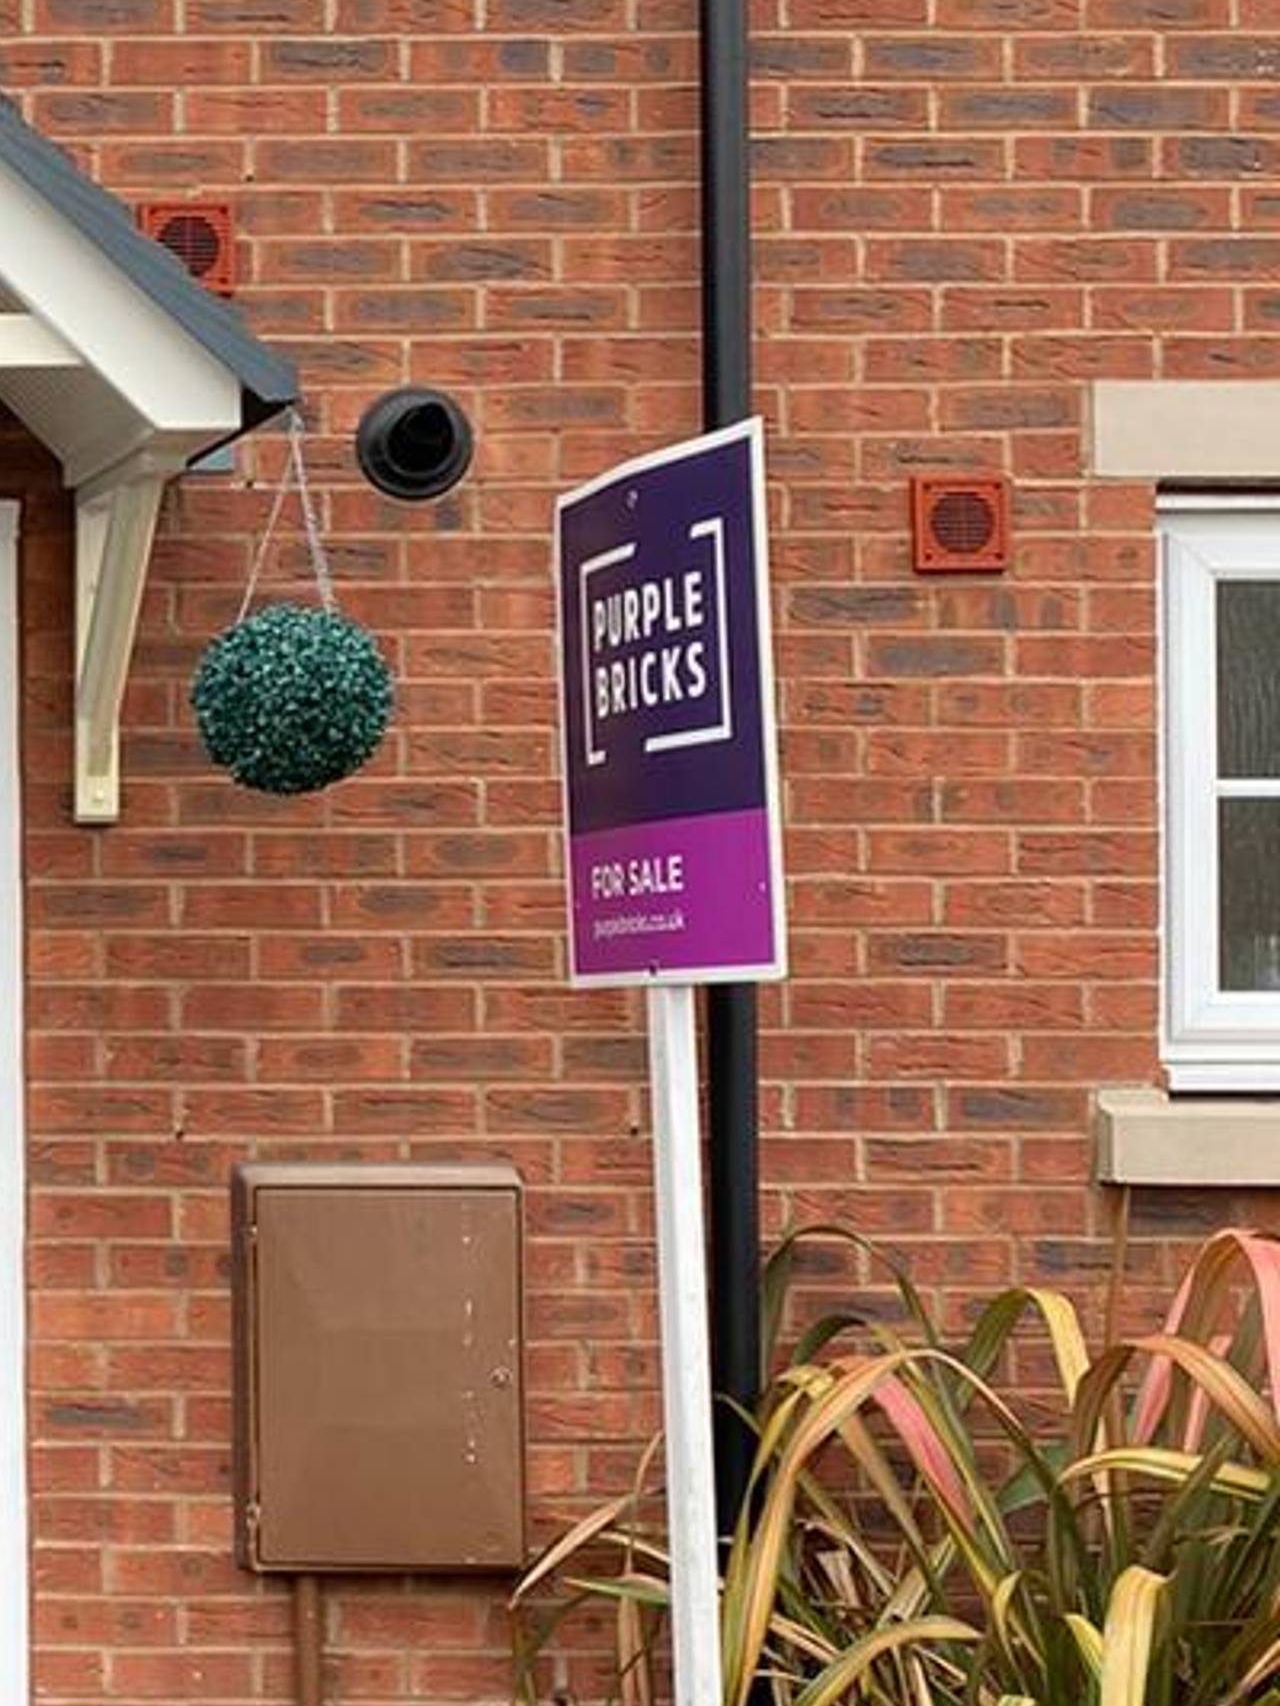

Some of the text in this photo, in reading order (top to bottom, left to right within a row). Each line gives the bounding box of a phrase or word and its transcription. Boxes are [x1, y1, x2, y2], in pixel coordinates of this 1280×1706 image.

[593, 571, 704, 651] PURPLE
[595, 642, 707, 718] BRICKS
[591, 854, 684, 899] FOR SALE
